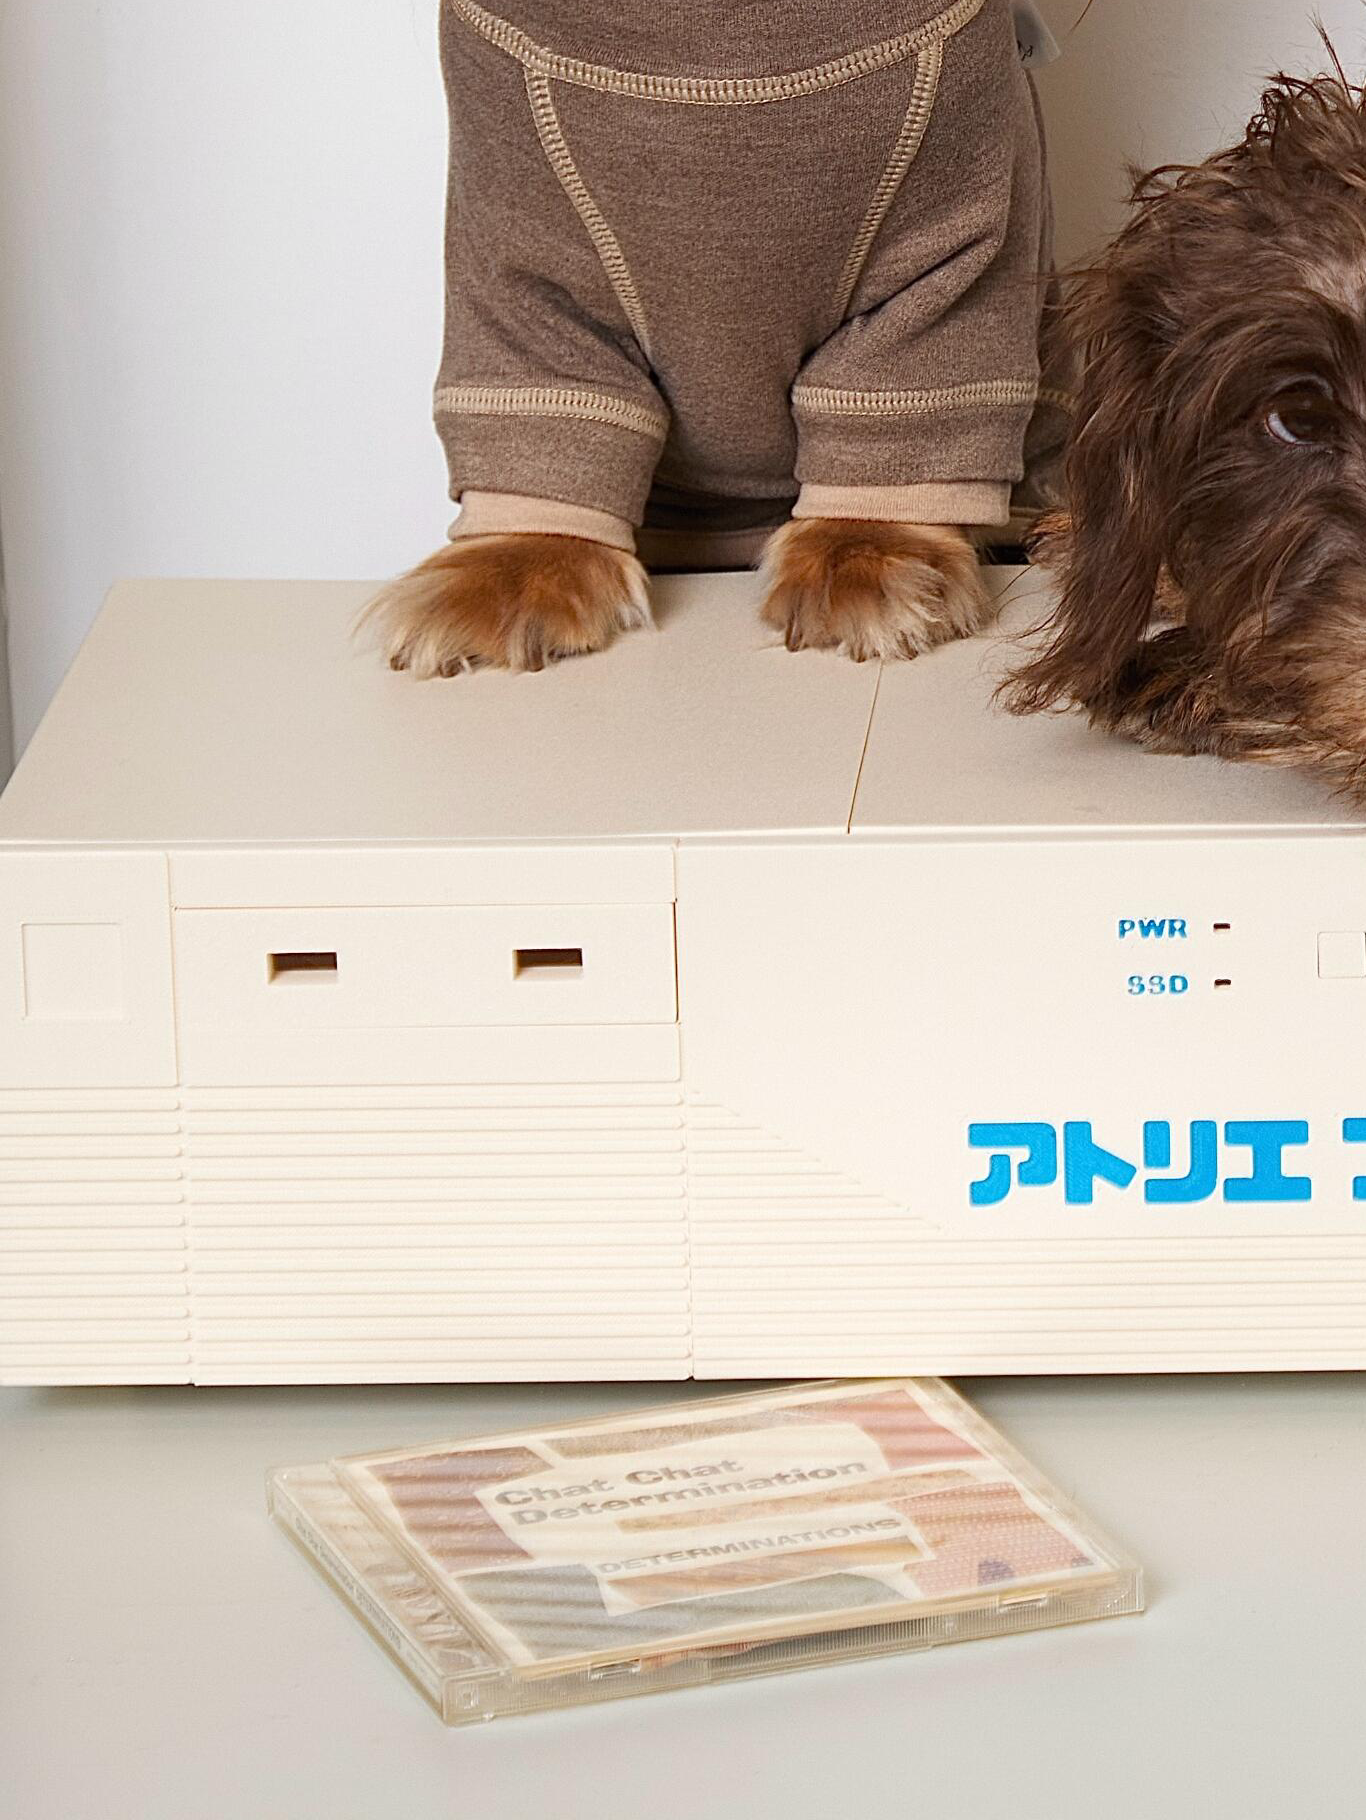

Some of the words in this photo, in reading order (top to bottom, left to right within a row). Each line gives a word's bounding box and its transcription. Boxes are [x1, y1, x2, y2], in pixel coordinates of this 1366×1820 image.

[1118, 918, 1188, 939] PWR
[1127, 975, 1189, 995] SSD
[967, 1118, 1312, 1206] アトリエ
[494, 1478, 615, 1507] Chat
[624, 1458, 745, 1486] Chat
[507, 1460, 869, 1527] Determination
[597, 1518, 903, 1576] DETERMINATIONS
